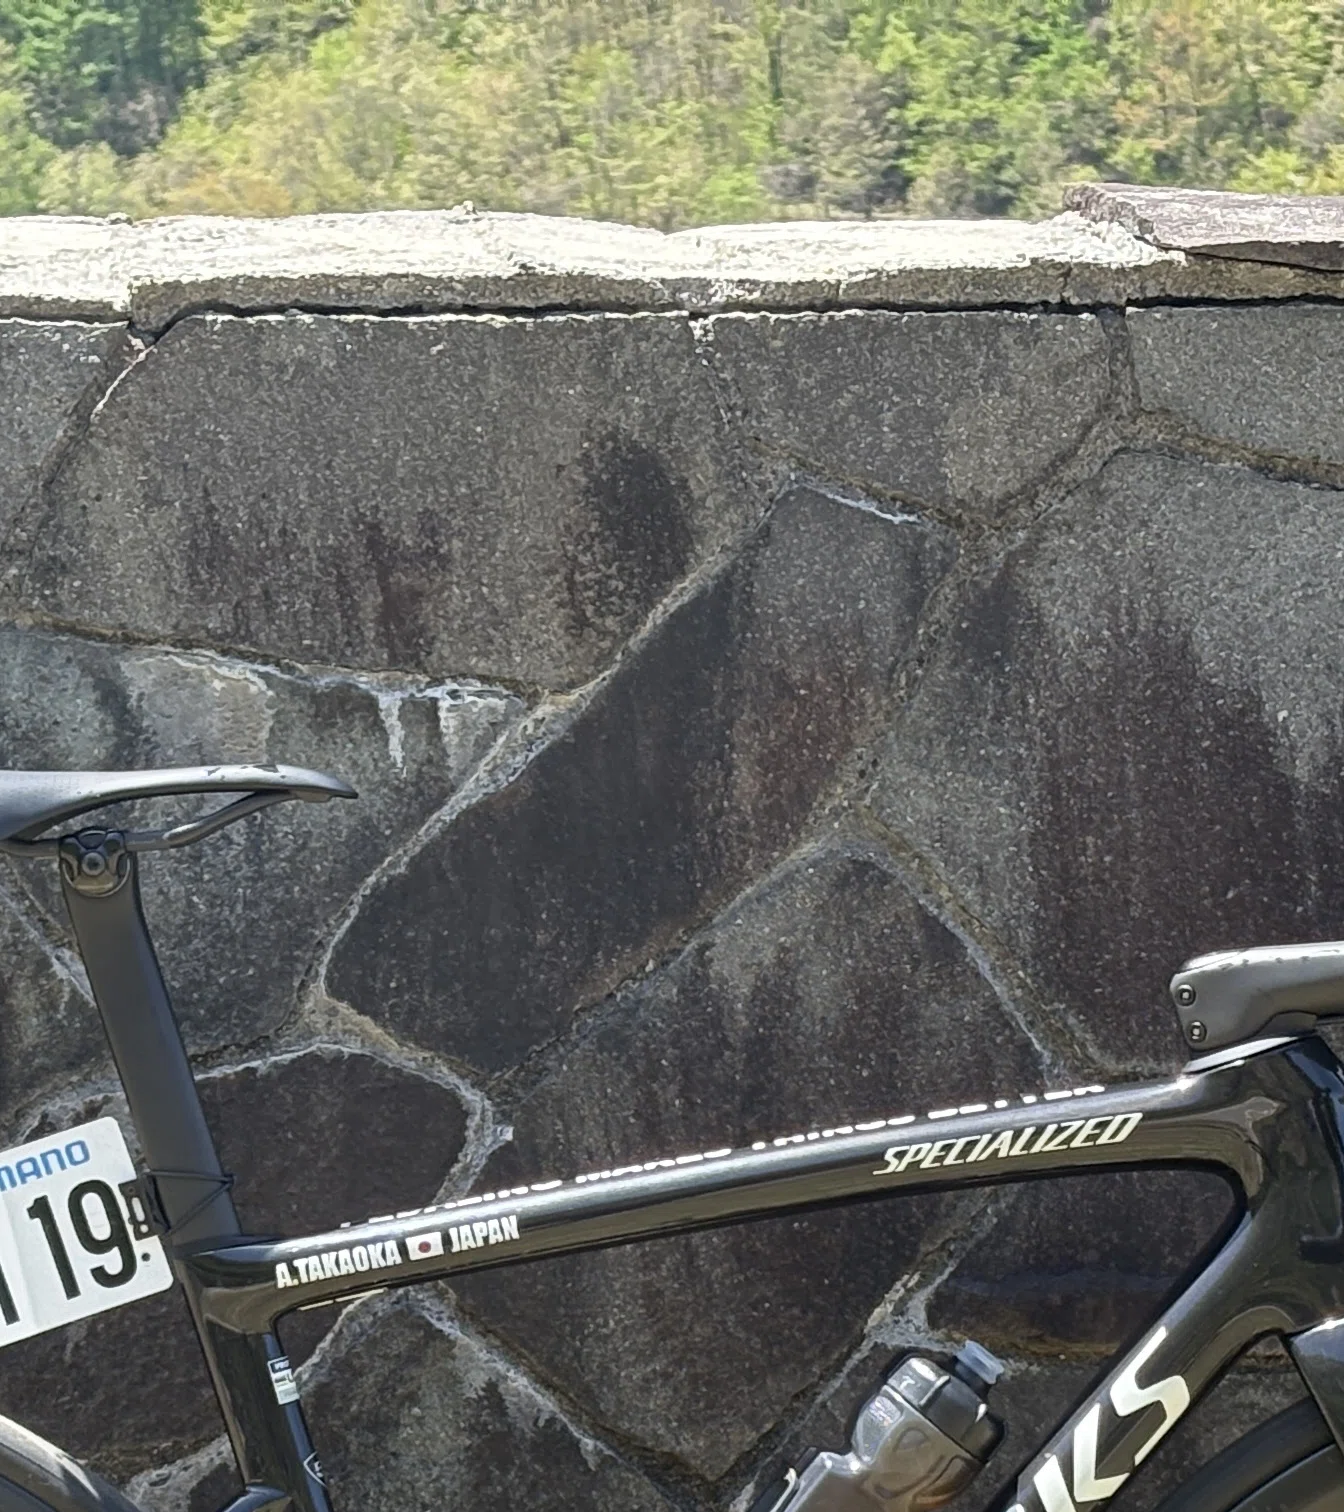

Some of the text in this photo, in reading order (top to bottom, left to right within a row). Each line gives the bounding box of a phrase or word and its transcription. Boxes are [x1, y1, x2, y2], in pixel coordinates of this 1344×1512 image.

[873, 1112, 1143, 1176] SPECIALIZED
[274, 1214, 520, 1289] A.TAKAOKA JAPAN
